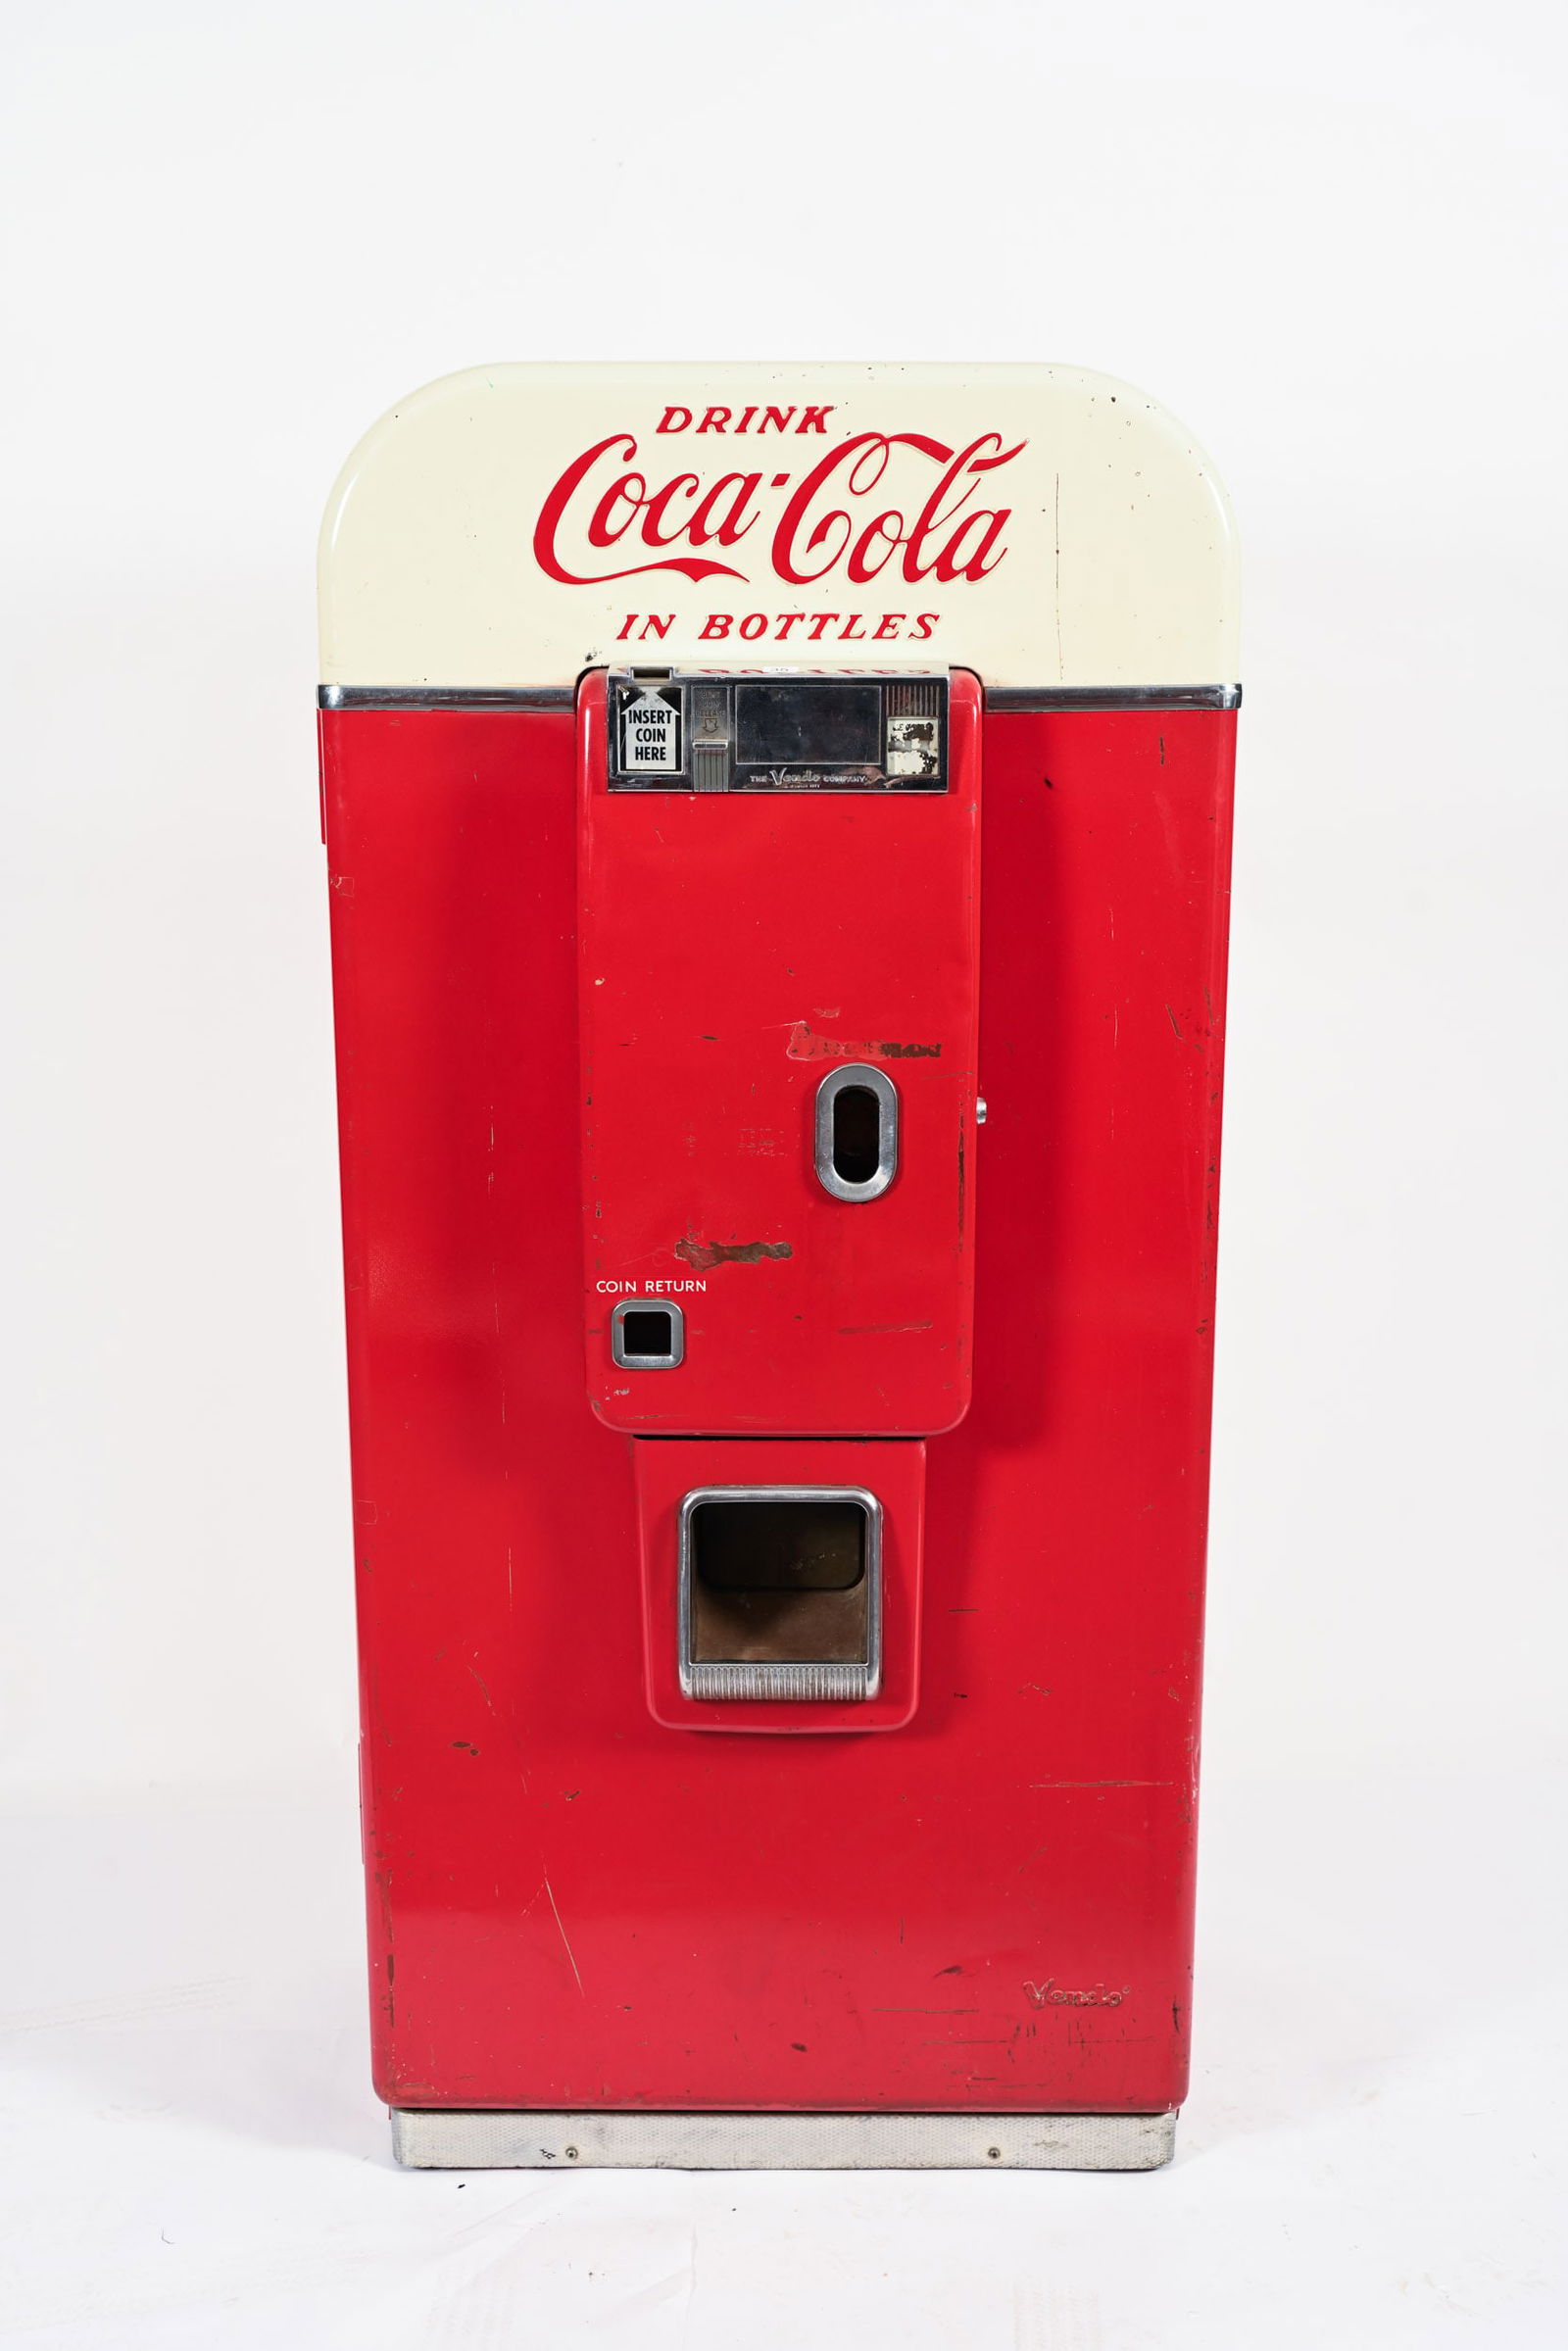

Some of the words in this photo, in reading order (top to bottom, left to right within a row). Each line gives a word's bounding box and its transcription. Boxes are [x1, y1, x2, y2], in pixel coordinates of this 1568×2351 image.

[655, 405, 834, 434] DRINK
[532, 431, 1028, 586] Coca-Cola
[615, 612, 676, 641] IN
[697, 612, 941, 641] BOTTLES
[628, 710, 672, 724] INSERT
[636, 728, 666, 742] COIN
[635, 747, 666, 760] HERE
[596, 1280, 637, 1294] COIN
[645, 1280, 707, 1293] RETURN
